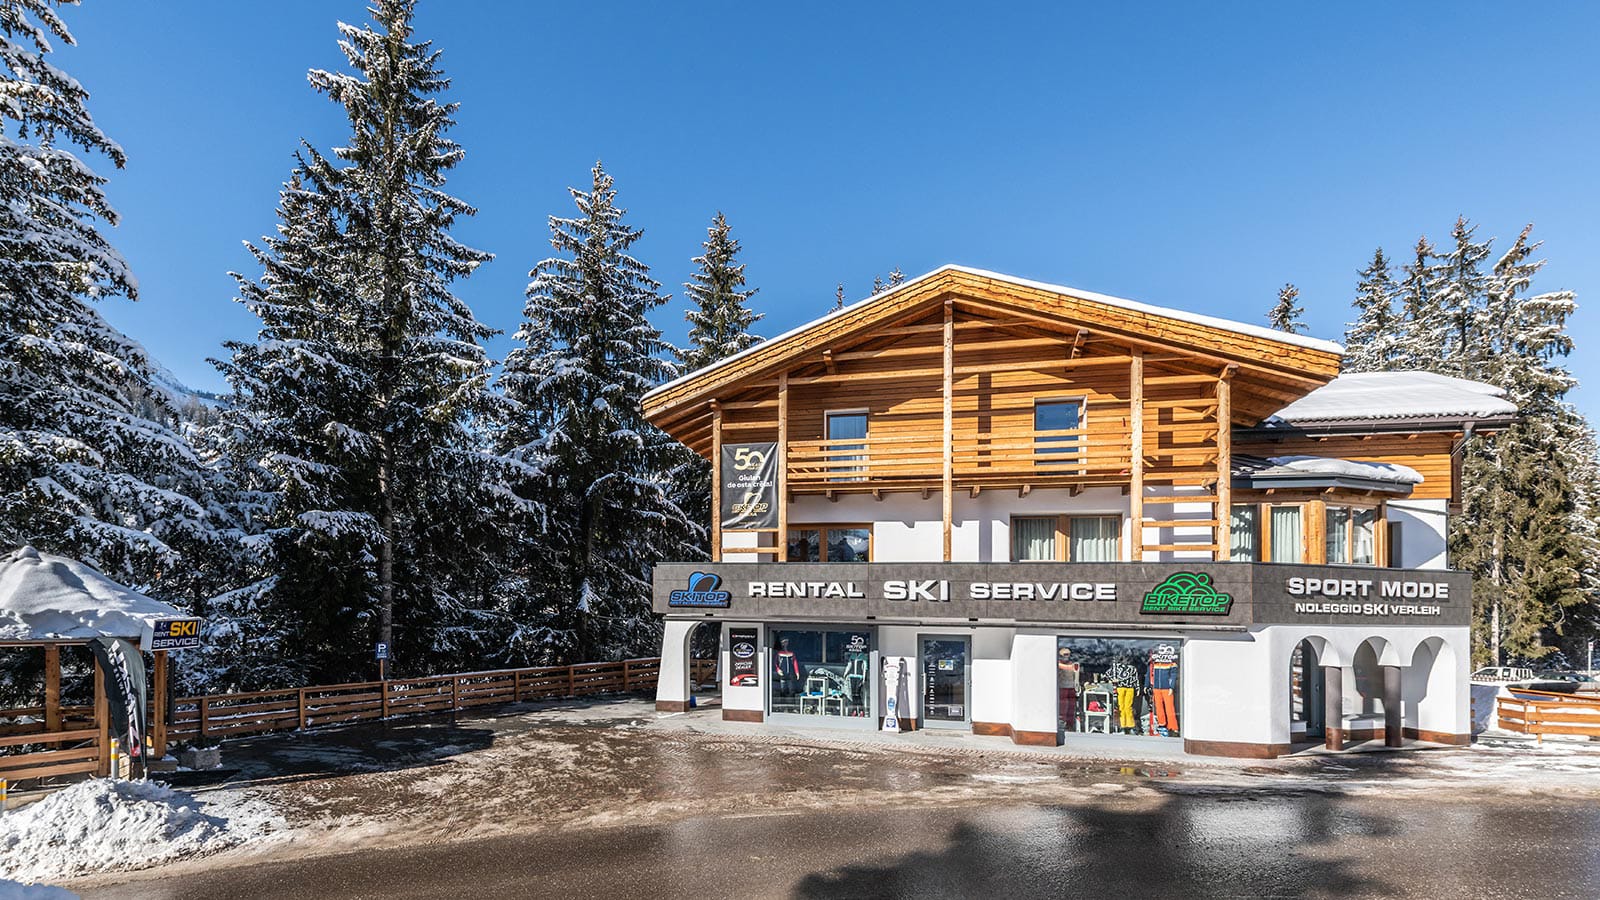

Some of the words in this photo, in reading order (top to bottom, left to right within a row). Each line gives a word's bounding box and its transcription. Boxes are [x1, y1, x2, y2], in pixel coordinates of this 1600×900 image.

[734, 448, 764, 470] 50
[748, 582, 865, 598] RENTAL
[883, 580, 949, 601] SKI
[970, 582, 1117, 600] SERVICE
[1288, 577, 1373, 597] SPORT
[1381, 580, 1449, 599] MODE
[671, 592, 727, 602] SKITOP
[1144, 593, 1229, 606] BIKETOP
[1295, 603, 1361, 613] NOLEGGIO
[1363, 603, 1388, 615] SKI
[1389, 605, 1441, 615] VERLEIH
[169, 621, 197, 637] SKI
[152, 637, 198, 648] SERVICE
[378, 643, 387, 653] P
